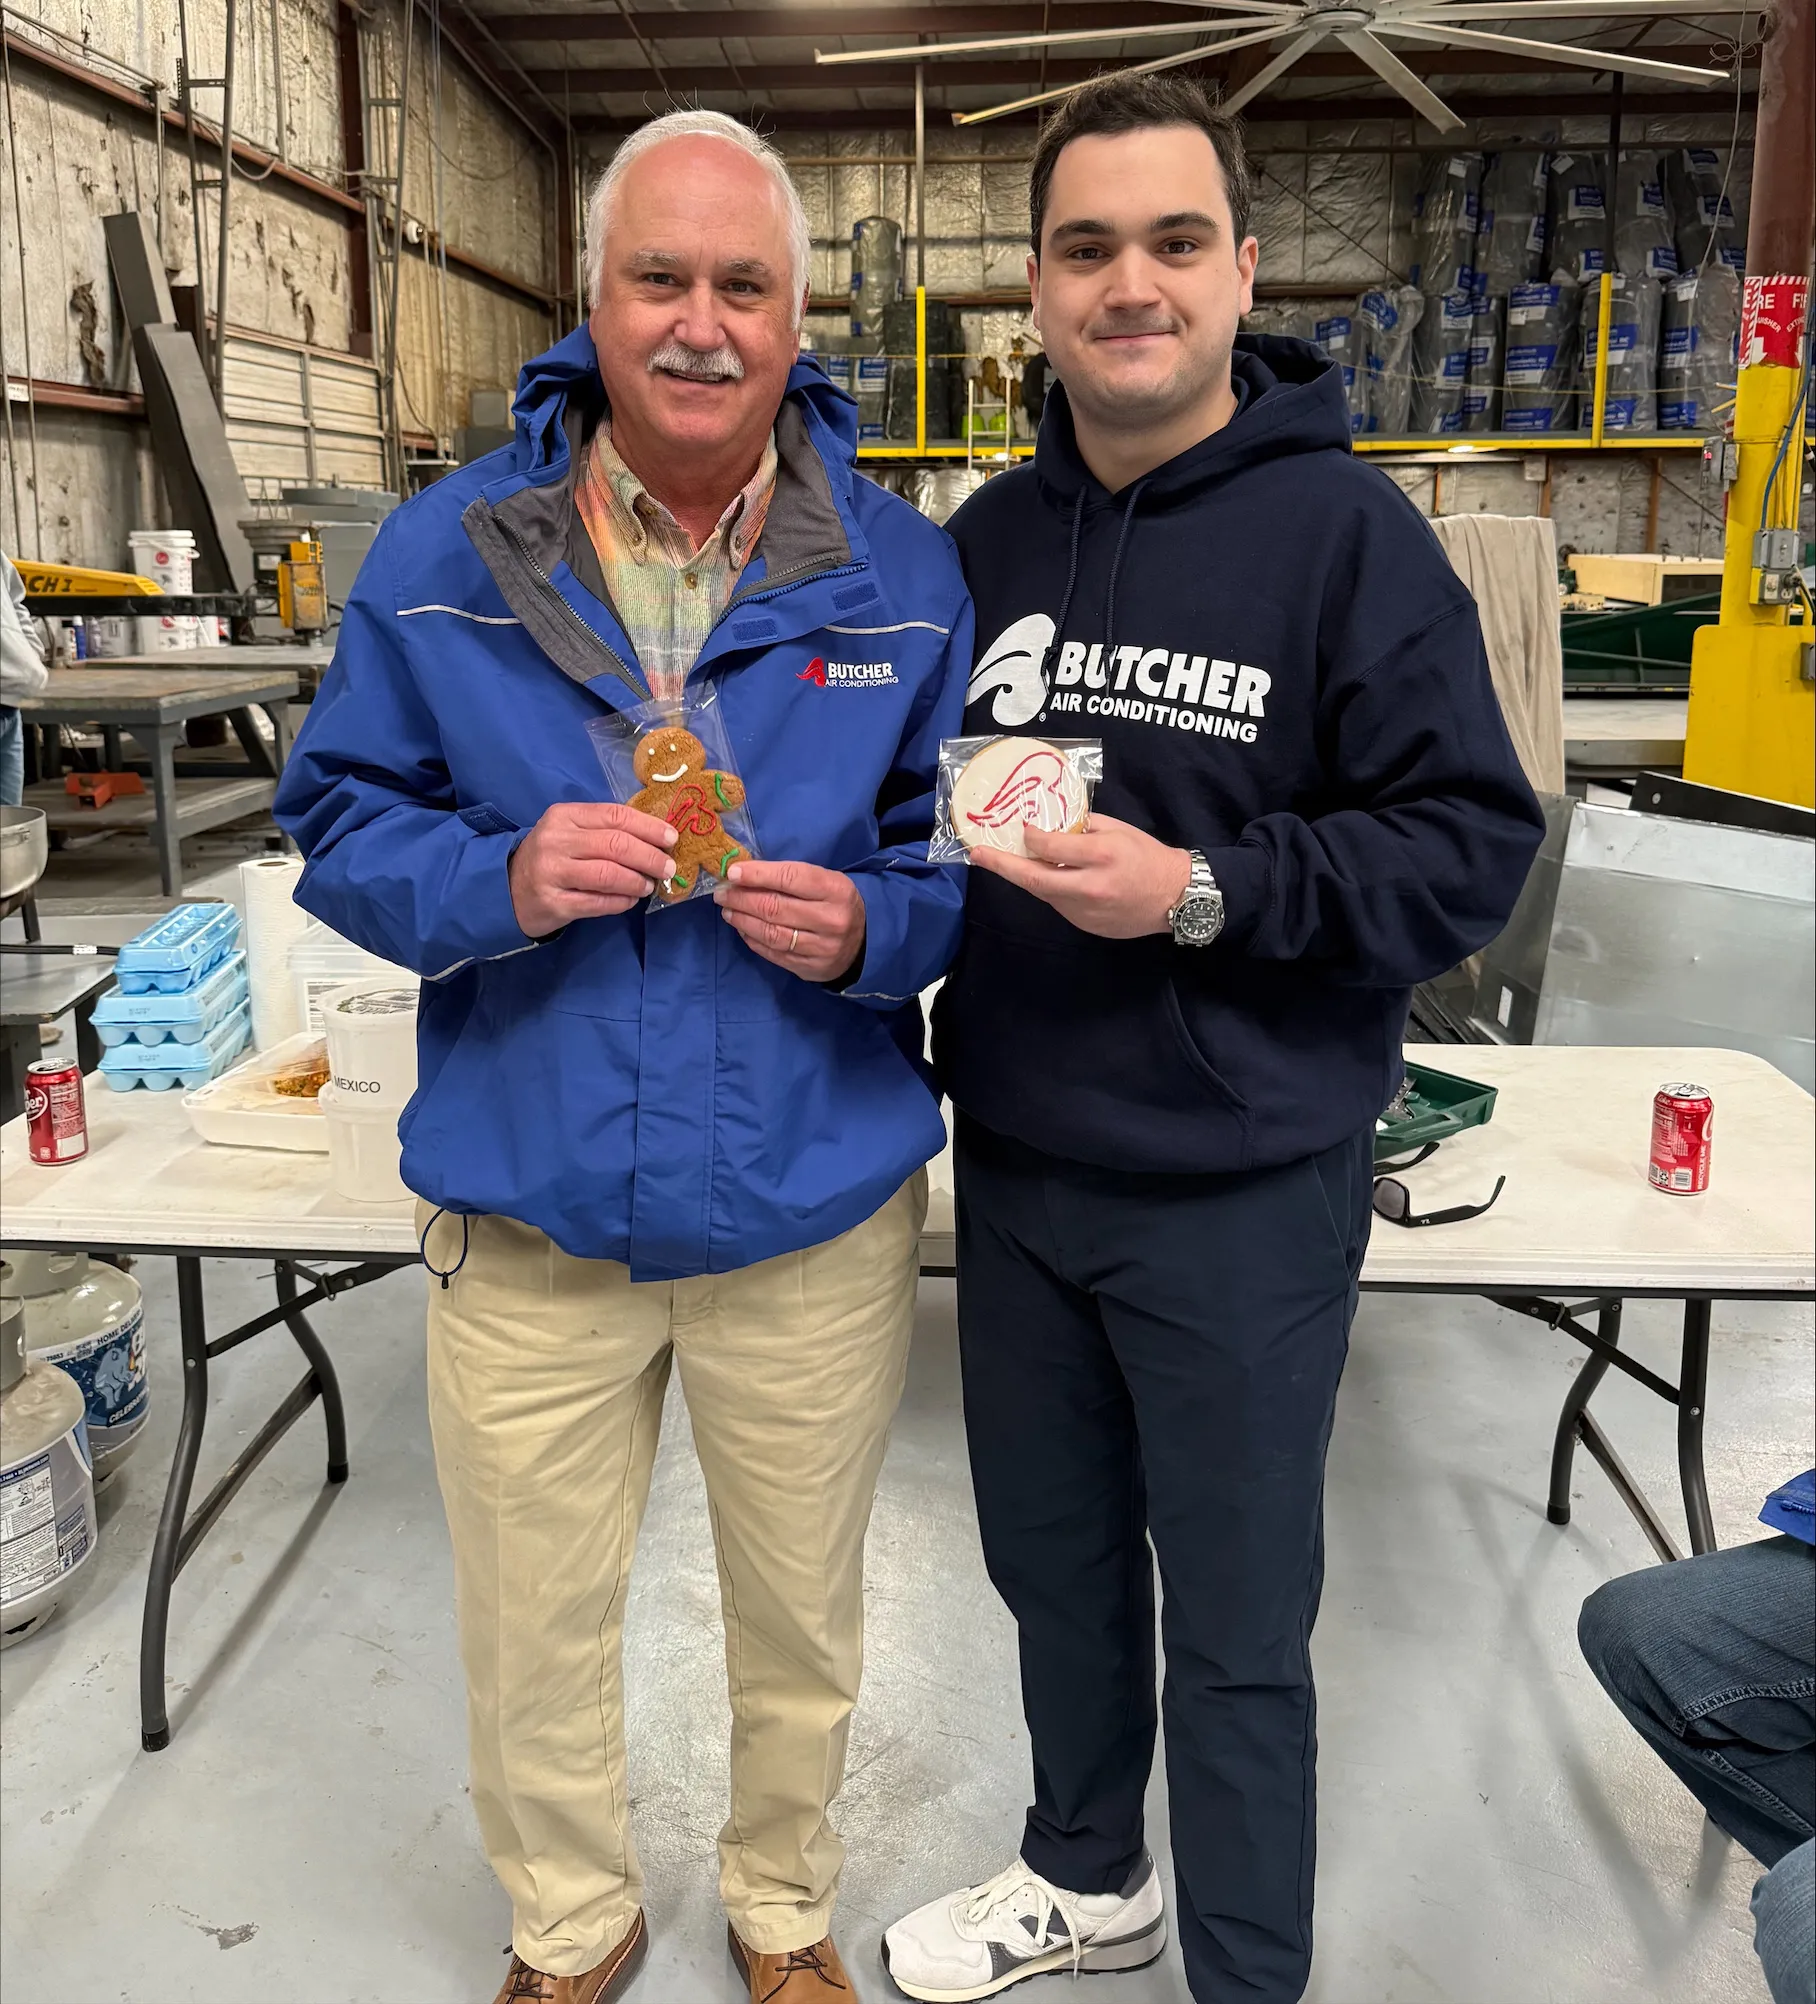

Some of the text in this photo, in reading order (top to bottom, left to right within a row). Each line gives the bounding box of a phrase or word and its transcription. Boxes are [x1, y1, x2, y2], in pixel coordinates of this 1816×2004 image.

[828, 662, 894, 680] BUTCHER
[1055, 641, 1272, 718] BUTCHER
[825, 676, 900, 688] AIR CONDITIONING
[1050, 691, 1258, 743] AIR CONDITIONING
[333, 1075, 381, 1094] MEXICO
[1697, 1157, 1706, 1190] RECYCLE
[97, 1328, 119, 1346] HOME
